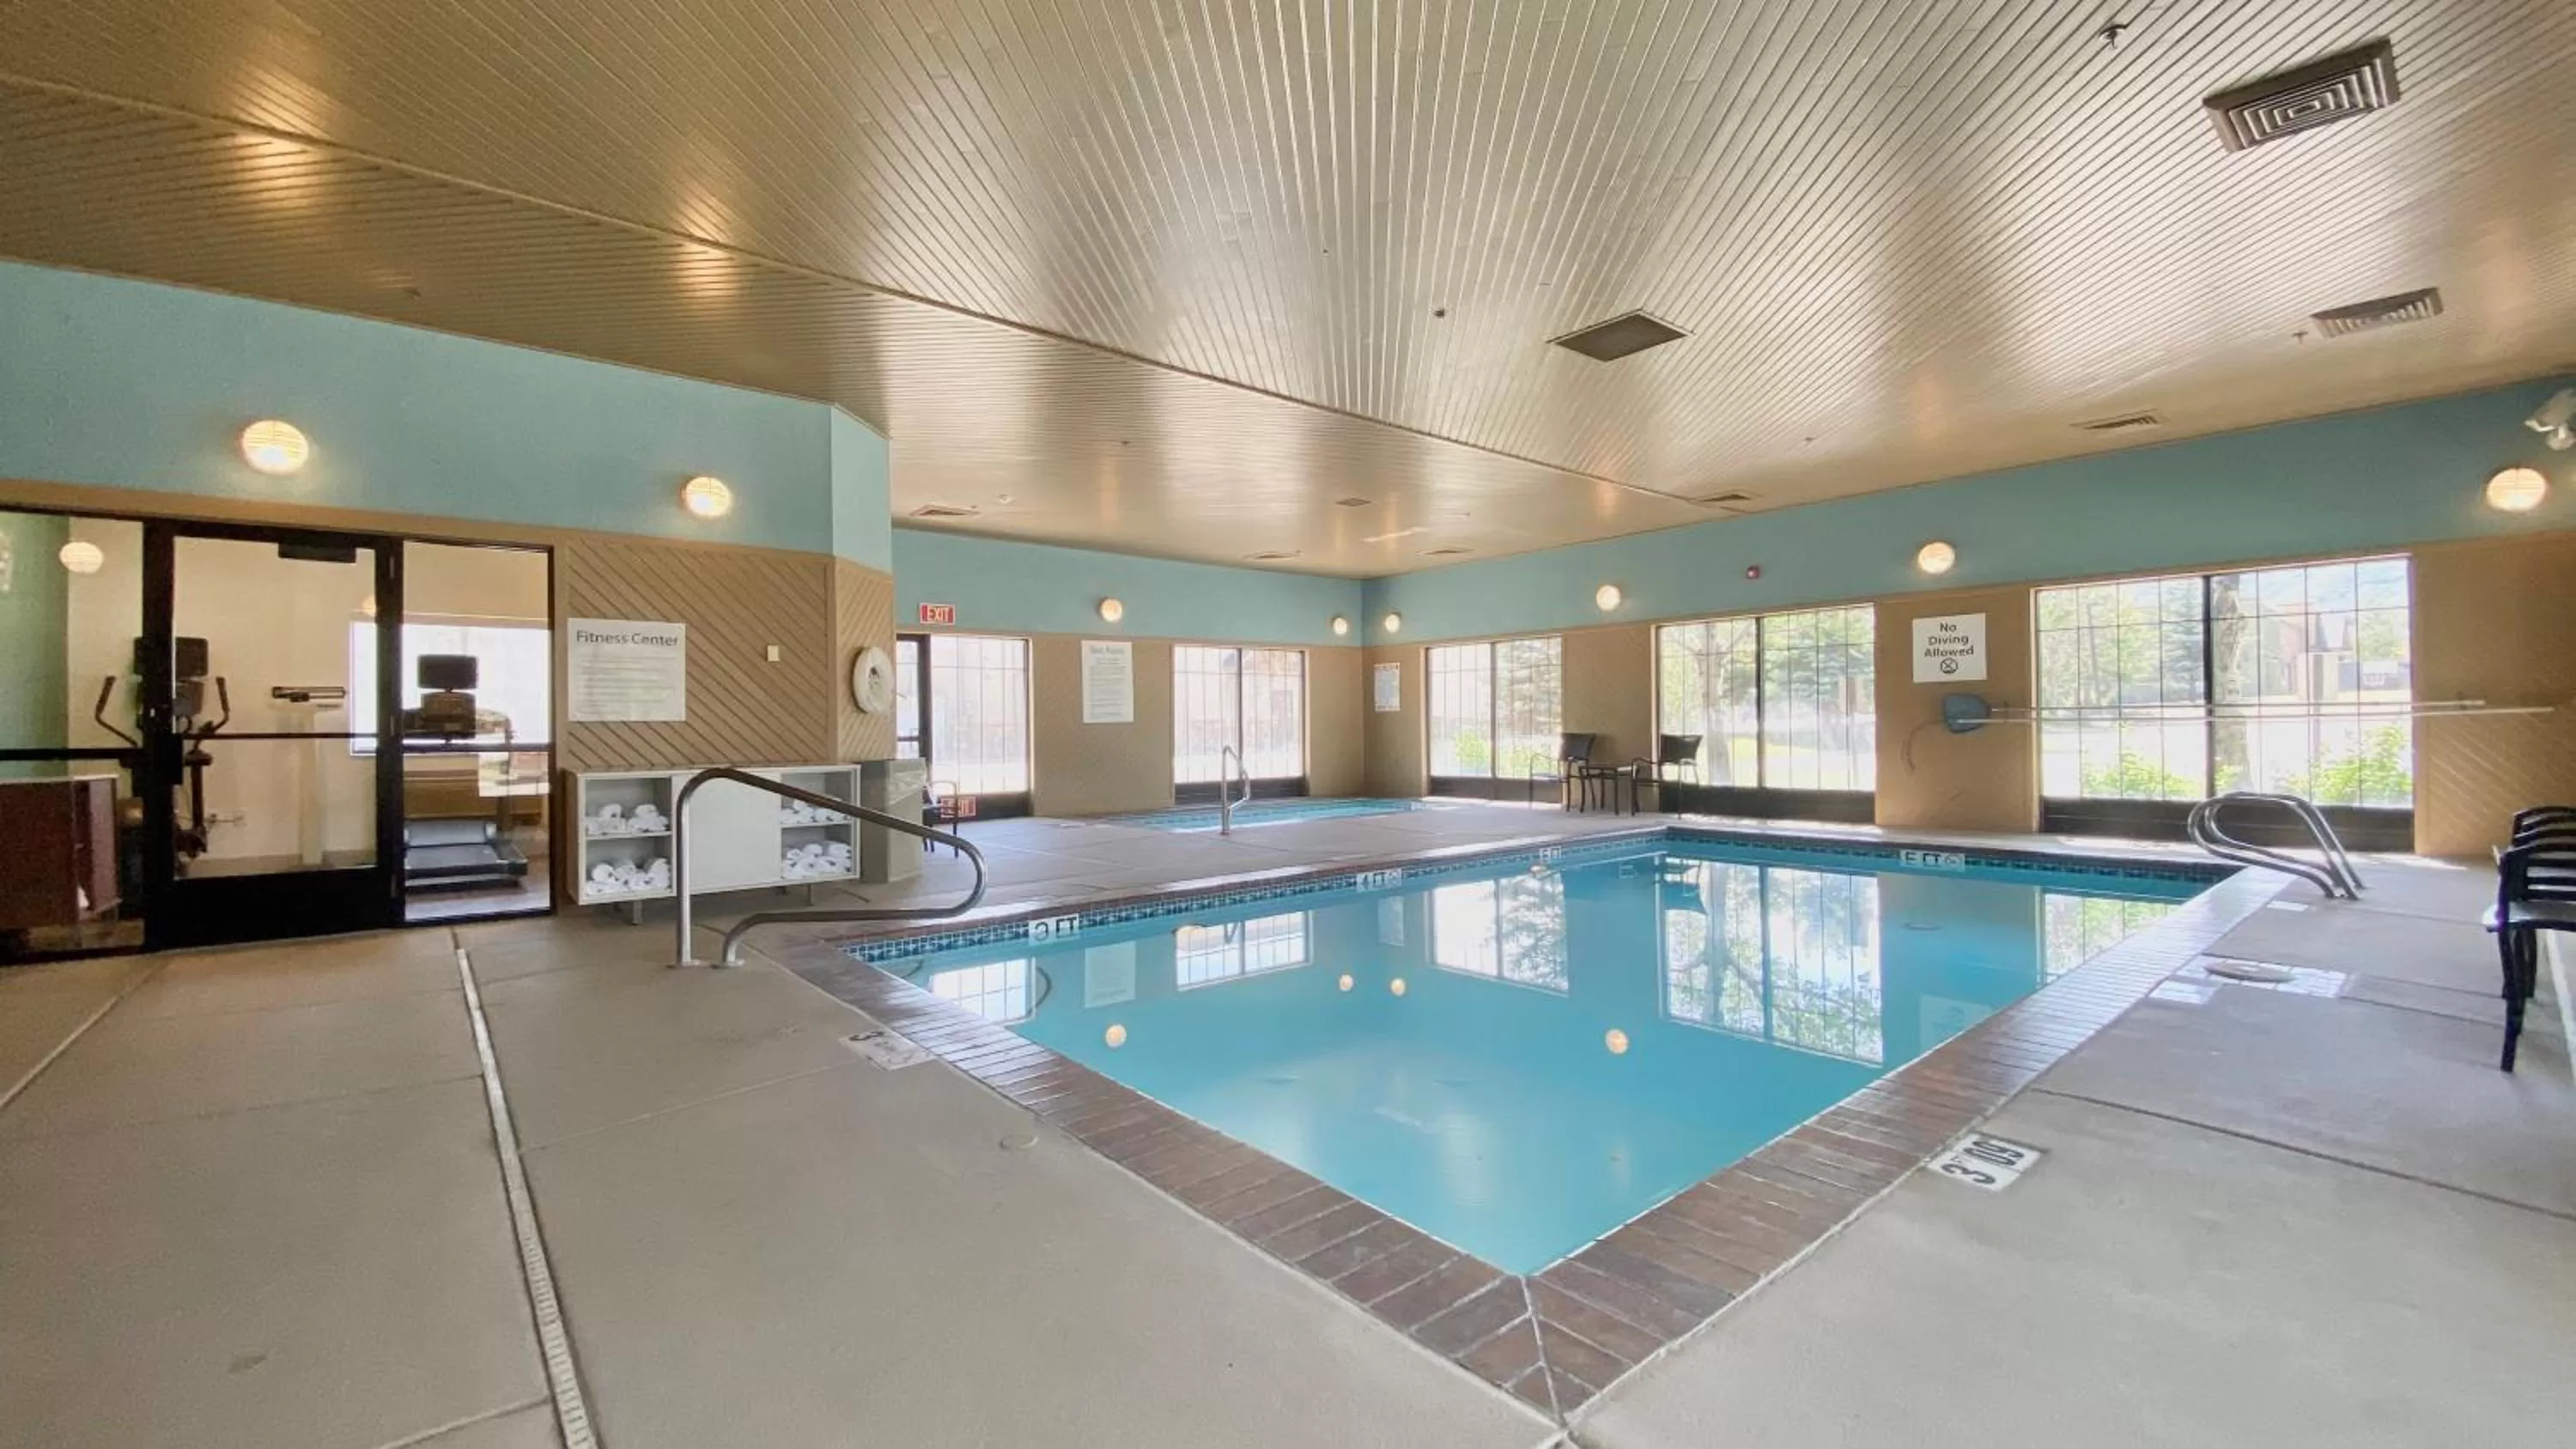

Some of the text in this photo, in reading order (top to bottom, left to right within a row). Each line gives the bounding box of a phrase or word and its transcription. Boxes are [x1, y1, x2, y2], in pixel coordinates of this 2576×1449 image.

[927, 606, 949, 622] EXIT
[1940, 622, 1957, 633] No
[576, 629, 678, 646] Fitness Center
[1927, 635, 1969, 646] Diving
[1924, 645, 1974, 658] Allowed
